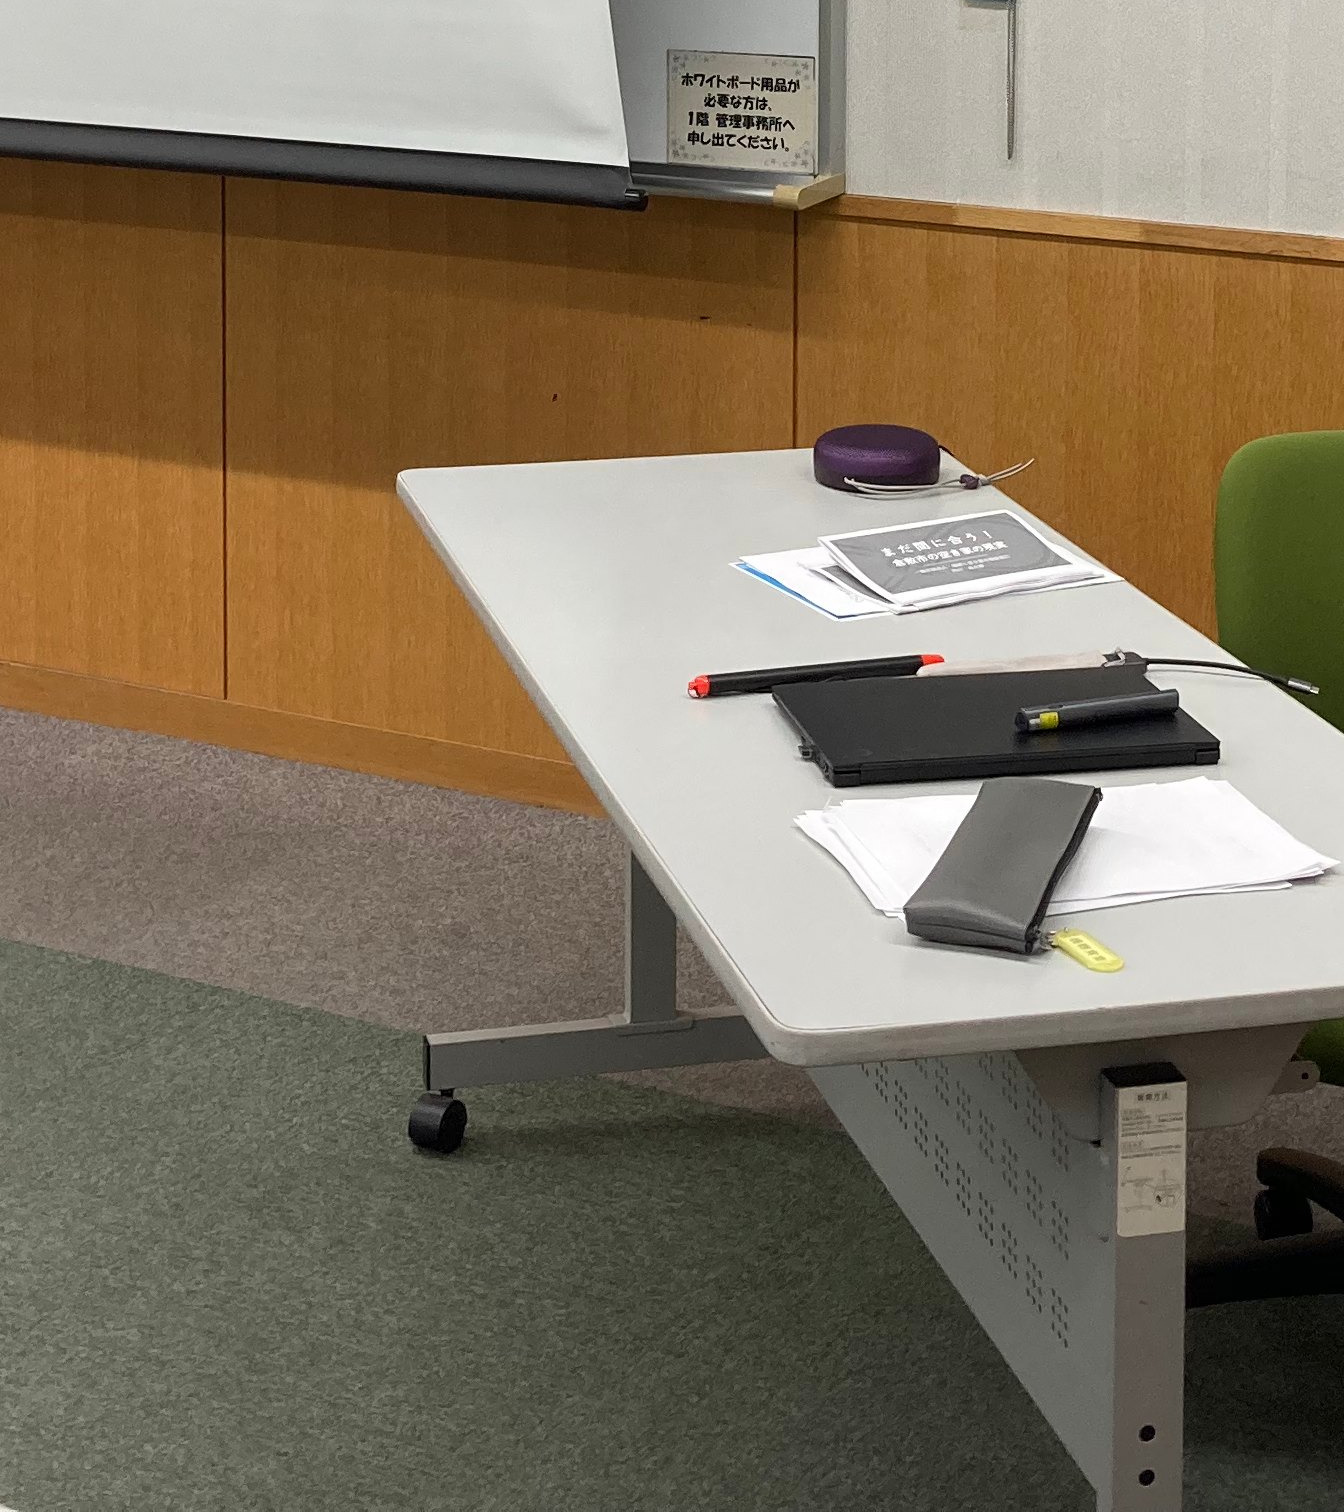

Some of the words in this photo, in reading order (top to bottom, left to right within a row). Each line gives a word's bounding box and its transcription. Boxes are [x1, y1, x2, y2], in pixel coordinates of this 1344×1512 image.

[681, 72, 800, 93] ホワイトボード用品が
[704, 93, 772, 111] 必要な方は、
[688, 111, 709, 127] 1階
[716, 113, 796, 132] 管理事務所へ
[688, 130, 790, 152] 申し出てください。
